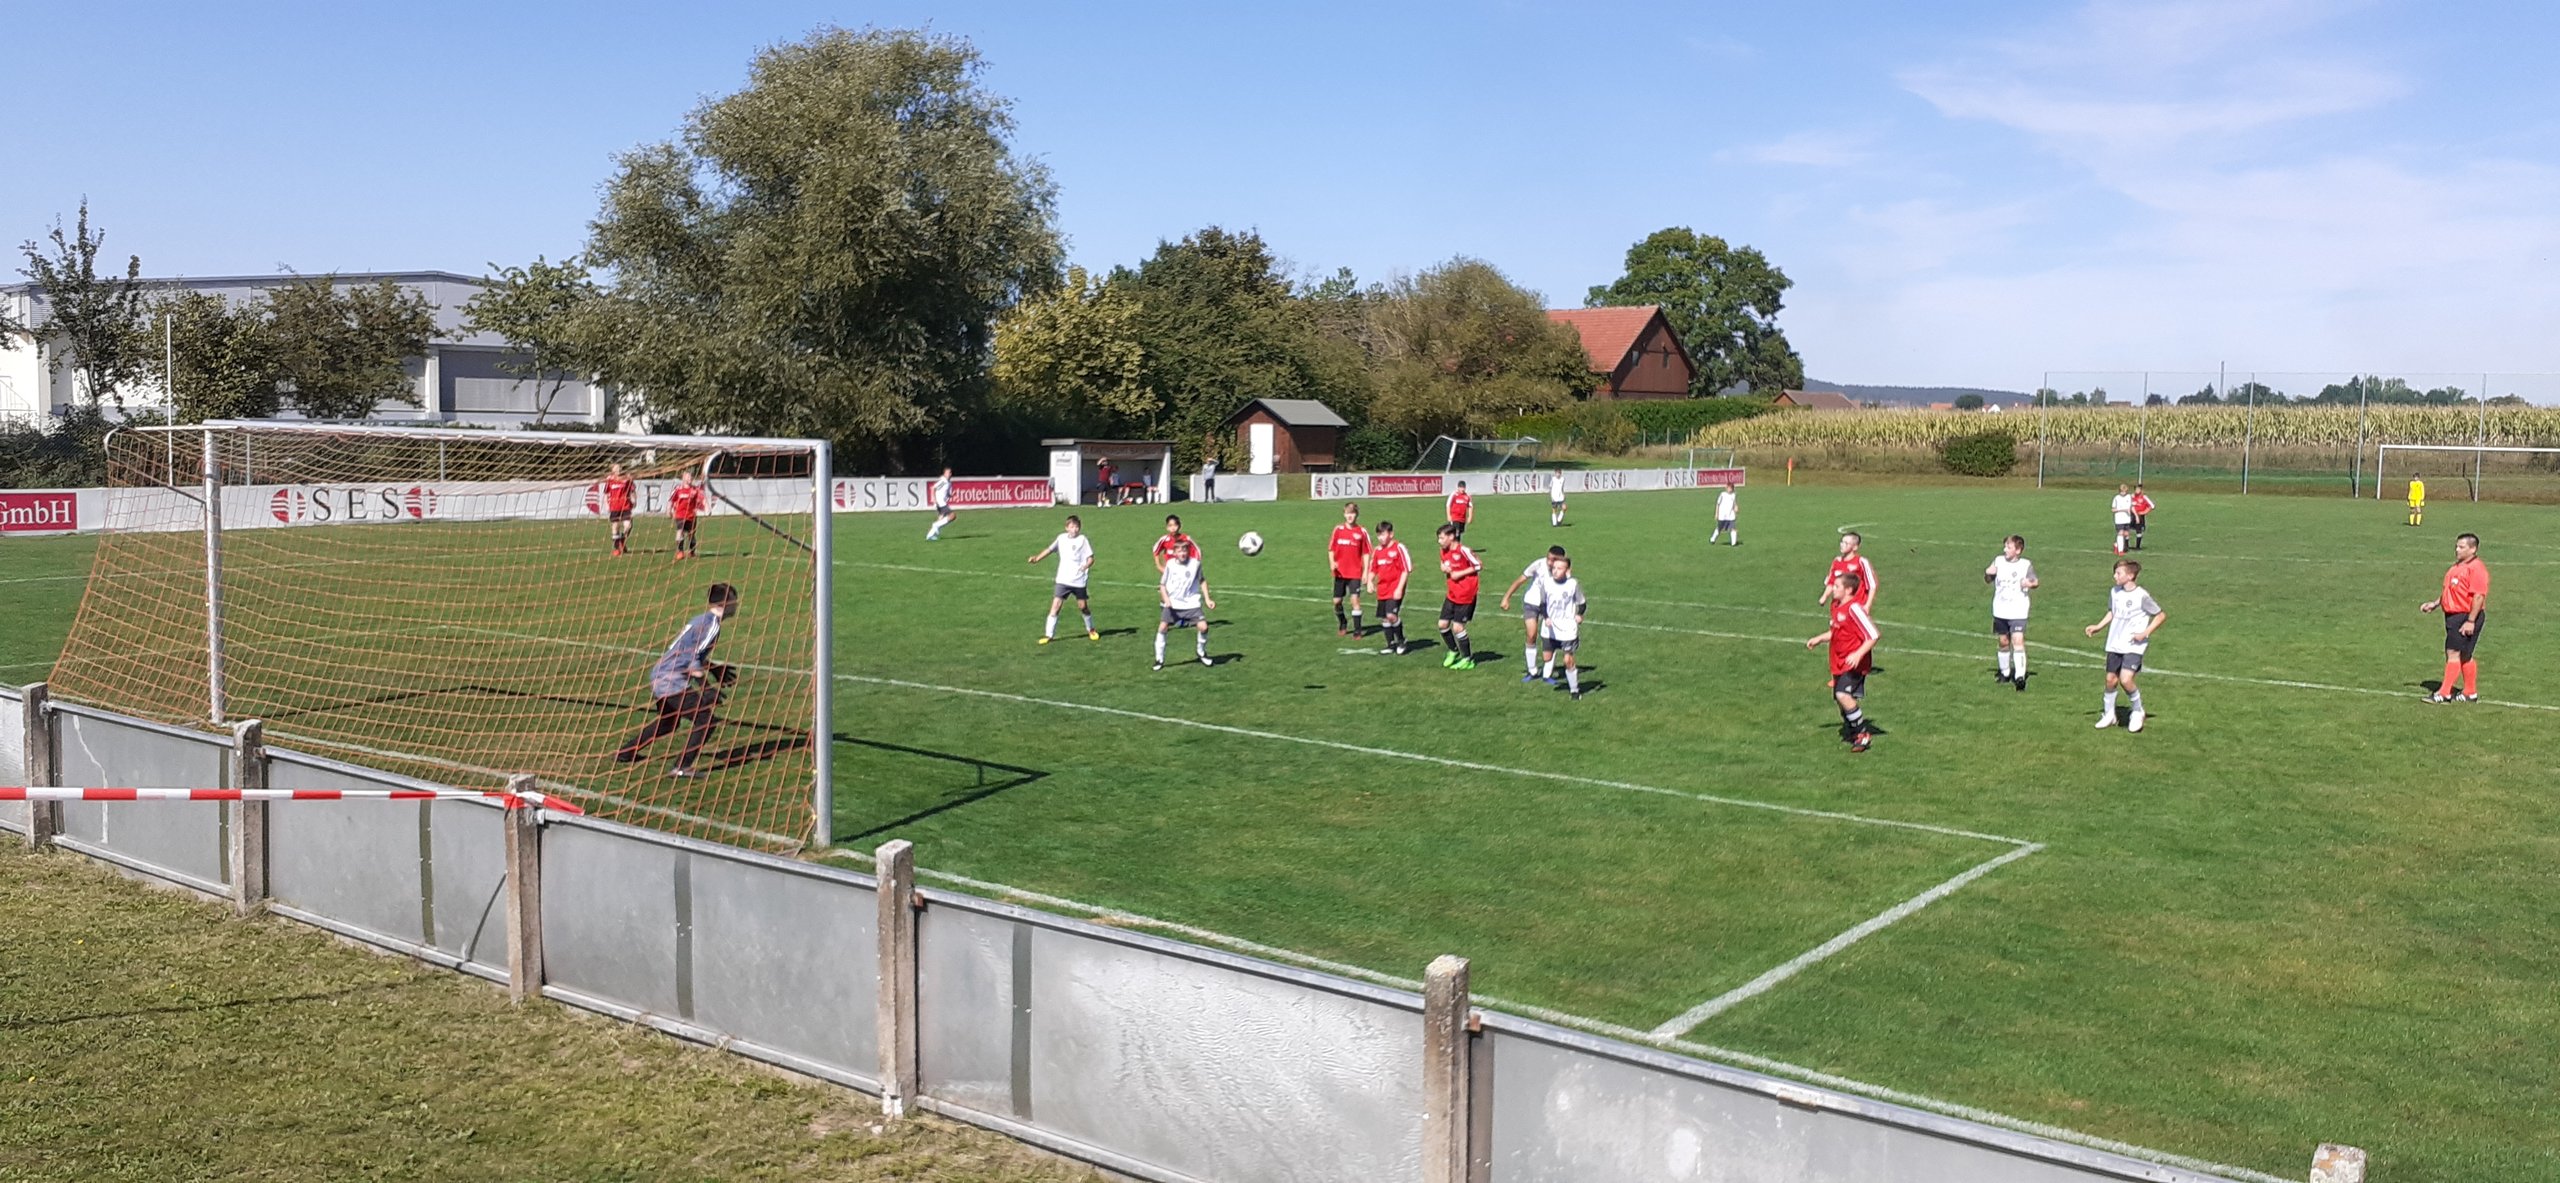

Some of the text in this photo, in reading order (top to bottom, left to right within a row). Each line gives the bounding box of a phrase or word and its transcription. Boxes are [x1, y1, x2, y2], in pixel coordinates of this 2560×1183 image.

[1332, 477, 1364, 496] SES
[1420, 479, 1441, 492] GmbH
[1503, 474, 1530, 492] SES
[1594, 472, 1617, 488] SES
[1674, 471, 1695, 487] SES
[863, 481, 1050, 508] SES ktrotechnik GmbH
[312, 487, 400, 522] SES
